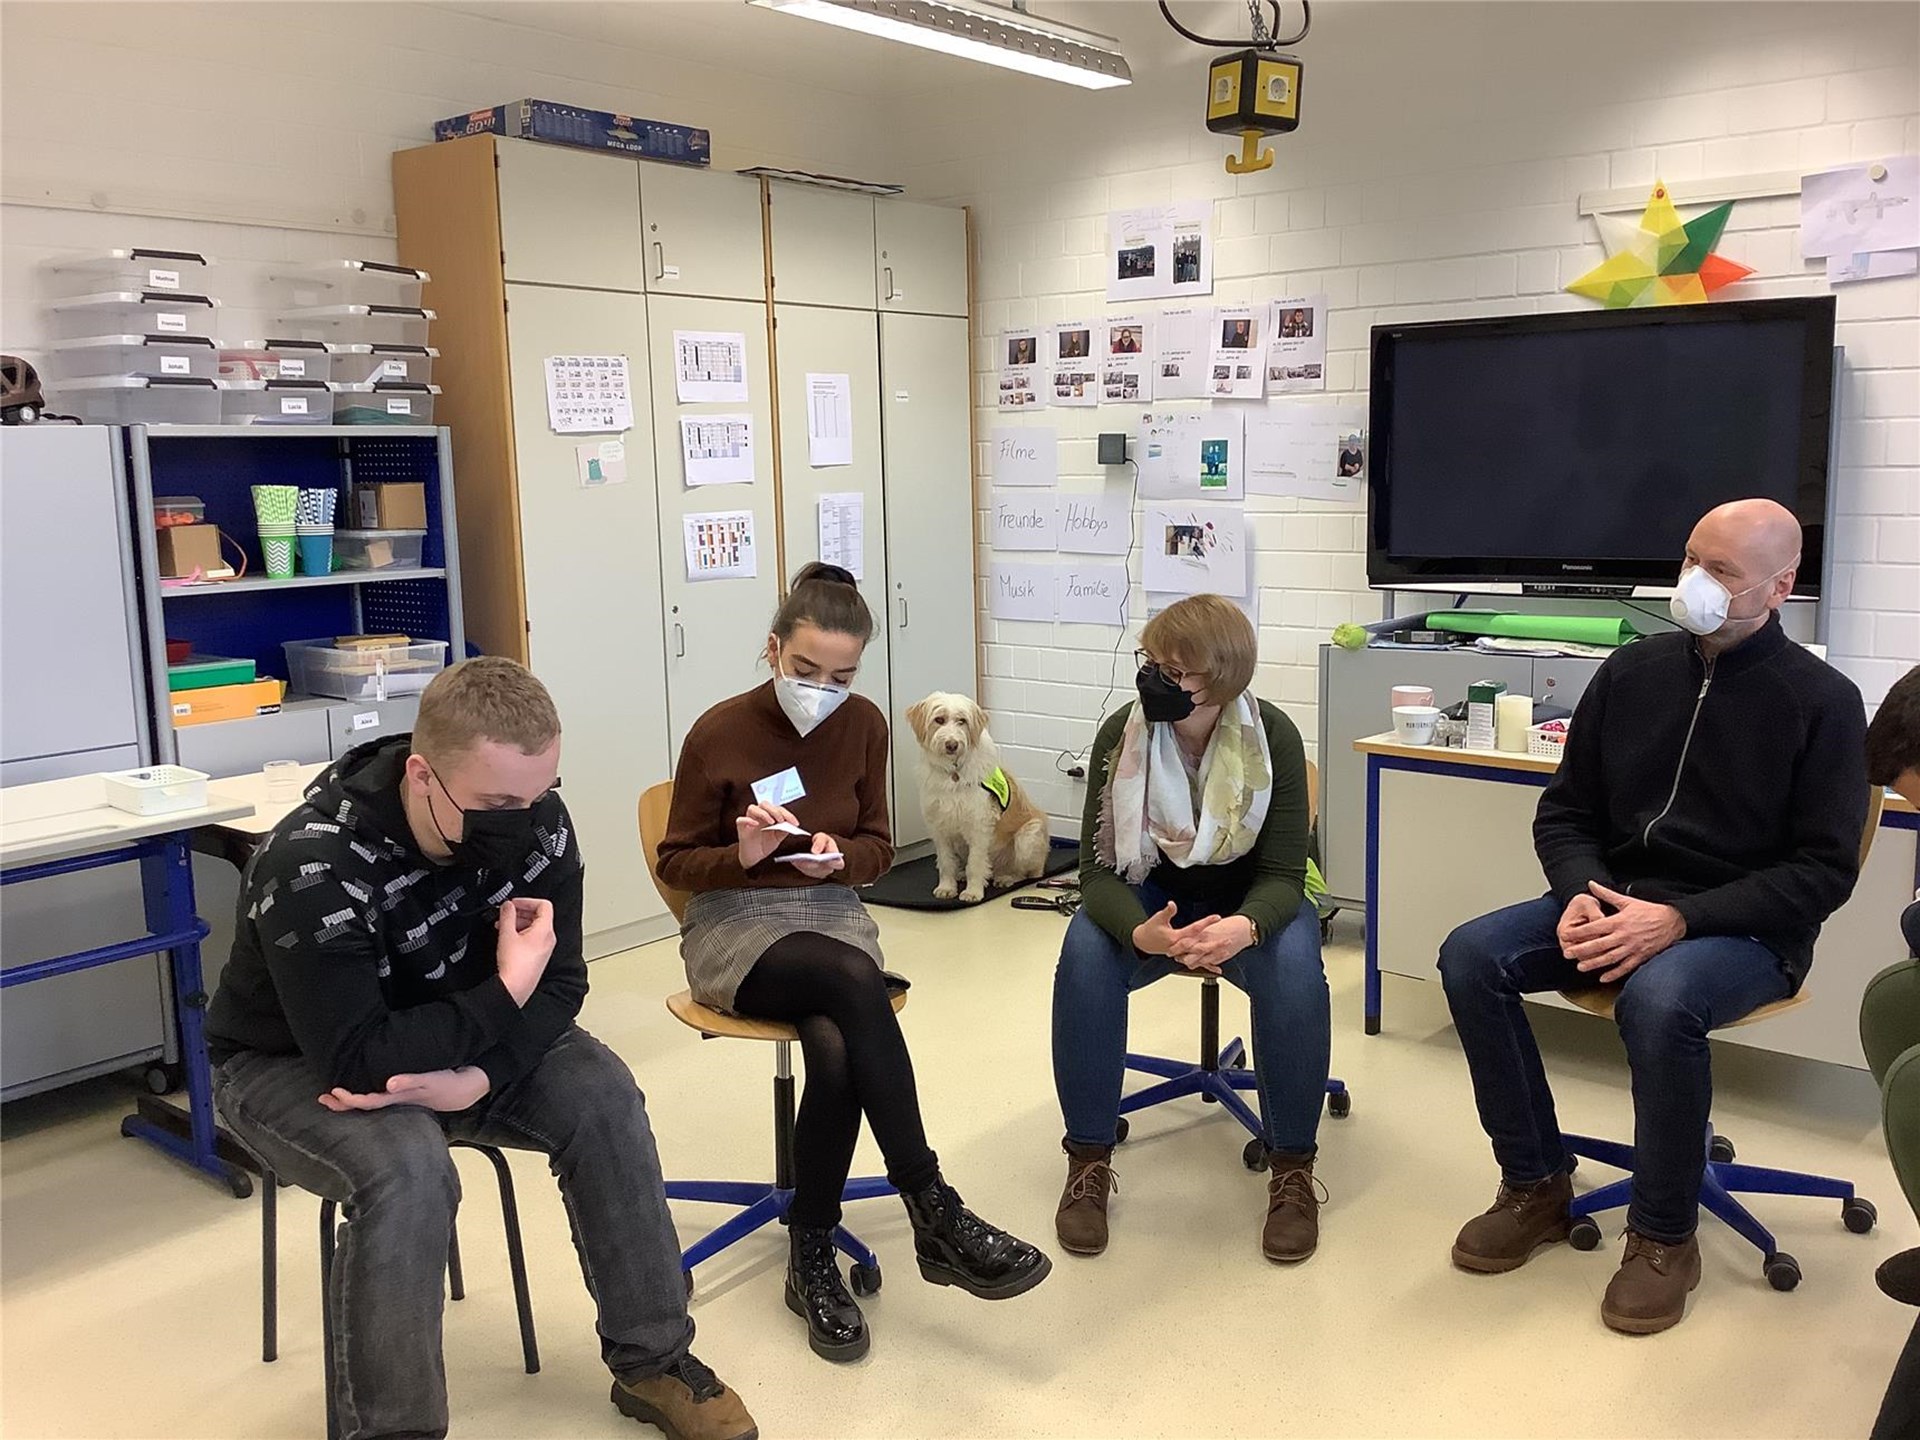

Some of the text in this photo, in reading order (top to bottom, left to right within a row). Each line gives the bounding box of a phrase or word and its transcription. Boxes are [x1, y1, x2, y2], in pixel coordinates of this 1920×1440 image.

[1000, 438, 1037, 461] Filme
[997, 503, 1045, 529] Freunde
[1064, 502, 1109, 537] Hobbys
[1562, 563, 1593, 571] Panasonic
[999, 574, 1035, 599] Musik
[1066, 574, 1111, 598] Familie
[305, 822, 341, 834] PUMA
[523, 854, 551, 883] PUMA
[321, 906, 357, 928] PUMA
